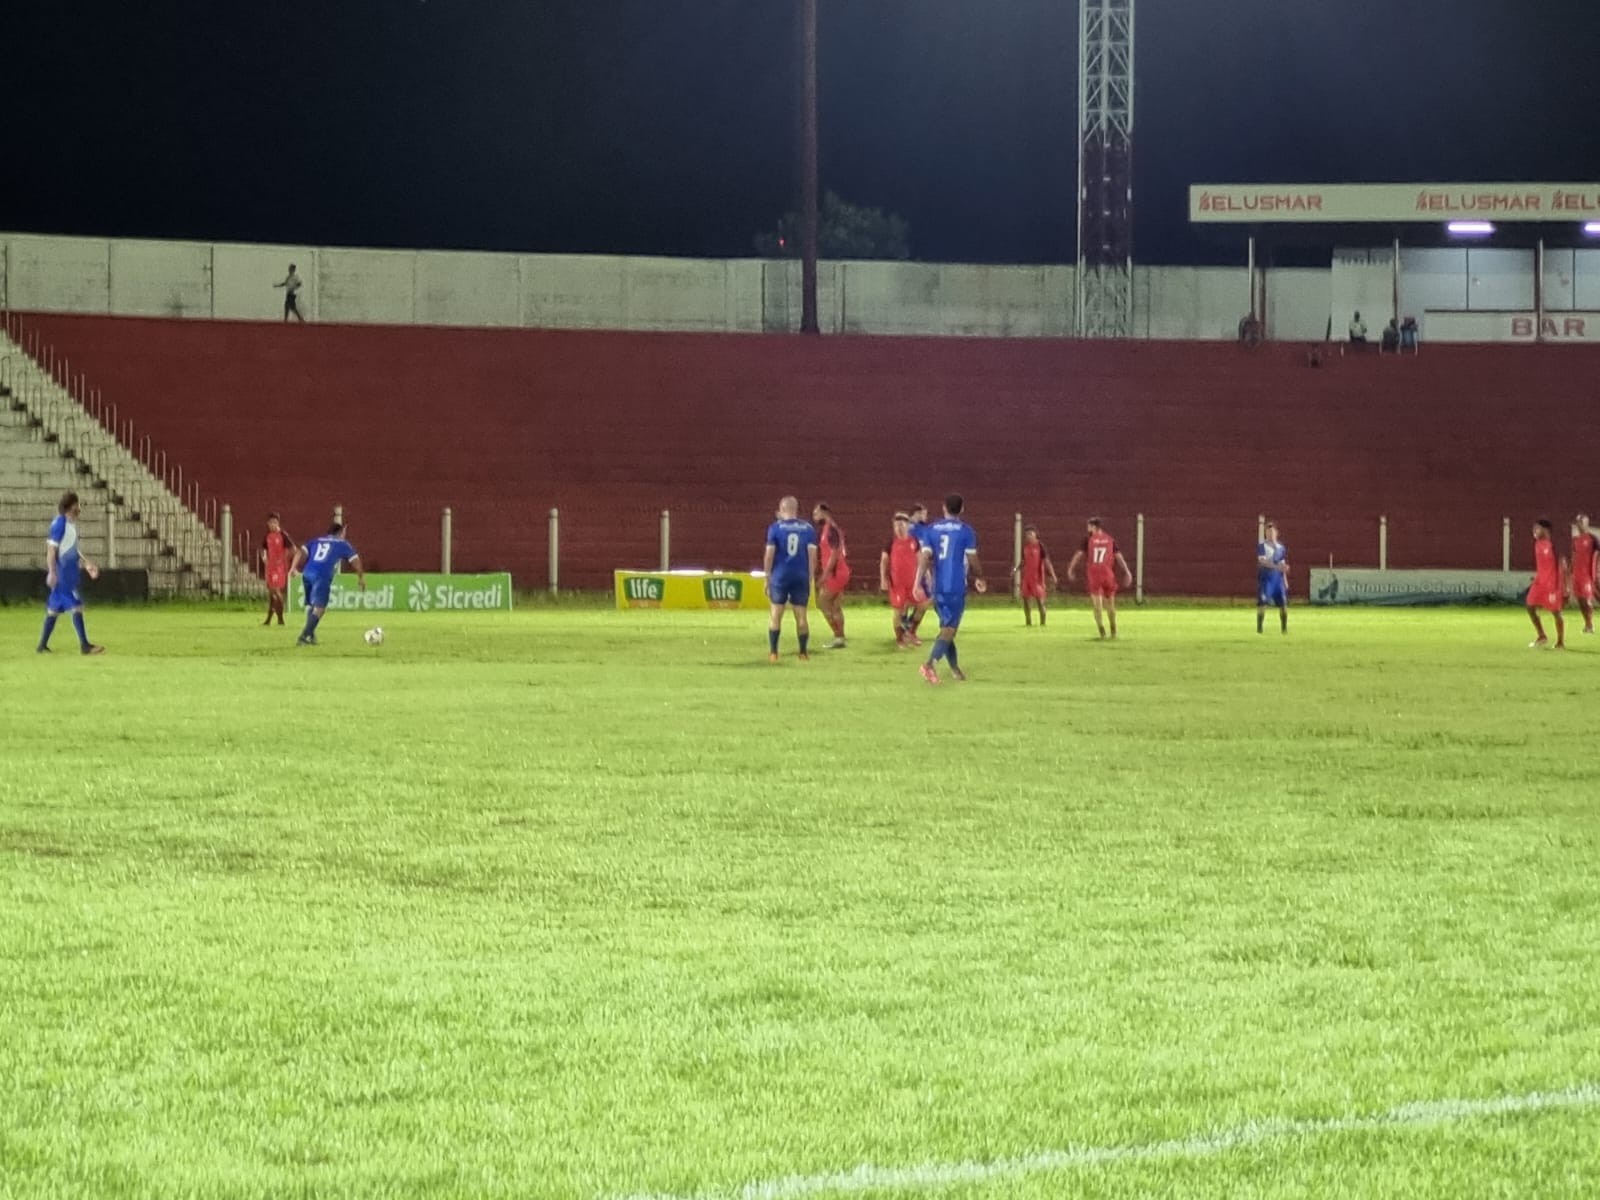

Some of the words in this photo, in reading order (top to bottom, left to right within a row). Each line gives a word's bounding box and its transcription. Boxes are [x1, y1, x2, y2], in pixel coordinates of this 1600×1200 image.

[1512, 317, 1586, 337] BAR
[939, 534, 950, 560] 3
[1093, 547, 1107, 564] 17
[435, 583, 502, 609] Sicredi
[630, 578, 658, 599] life
[710, 579, 736, 599] life
